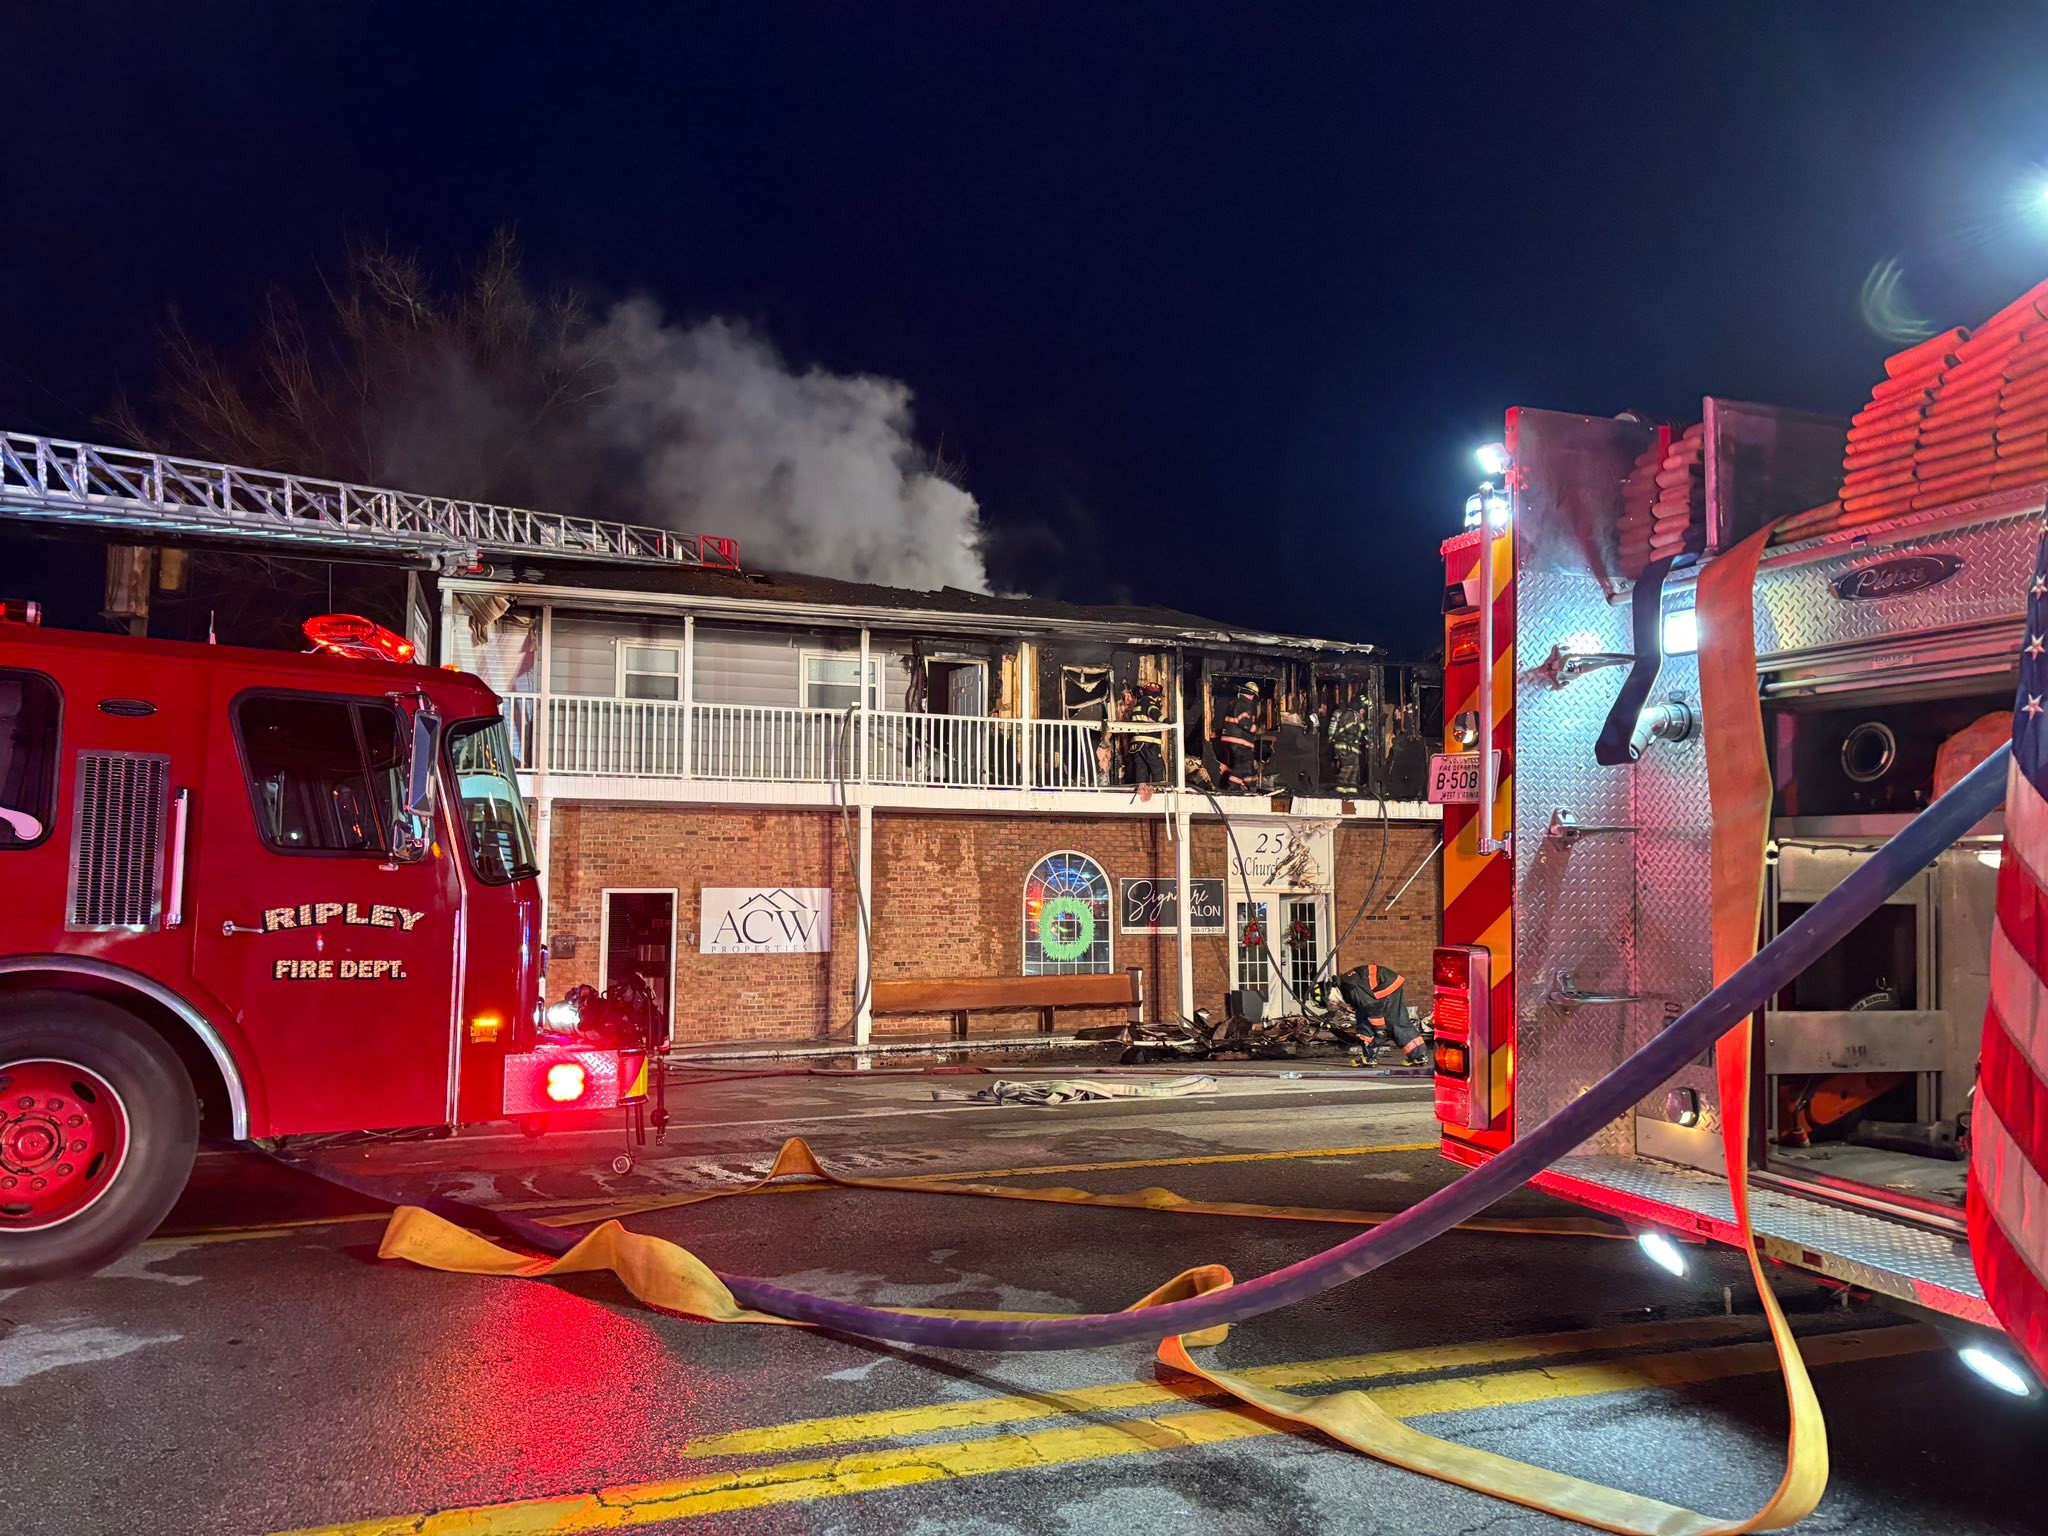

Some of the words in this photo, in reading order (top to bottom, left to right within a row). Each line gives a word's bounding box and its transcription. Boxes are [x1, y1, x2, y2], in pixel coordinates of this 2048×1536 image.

[1436, 771, 1478, 790] B-508
[1127, 880, 1209, 922] Signre
[263, 902, 426, 932] RIPLEY
[1190, 905, 1221, 917] ALON
[711, 909, 820, 944] ACW
[711, 944, 808, 953] PROPERTIES
[274, 960, 334, 979] FIRE
[340, 960, 407, 979] DEPT.
